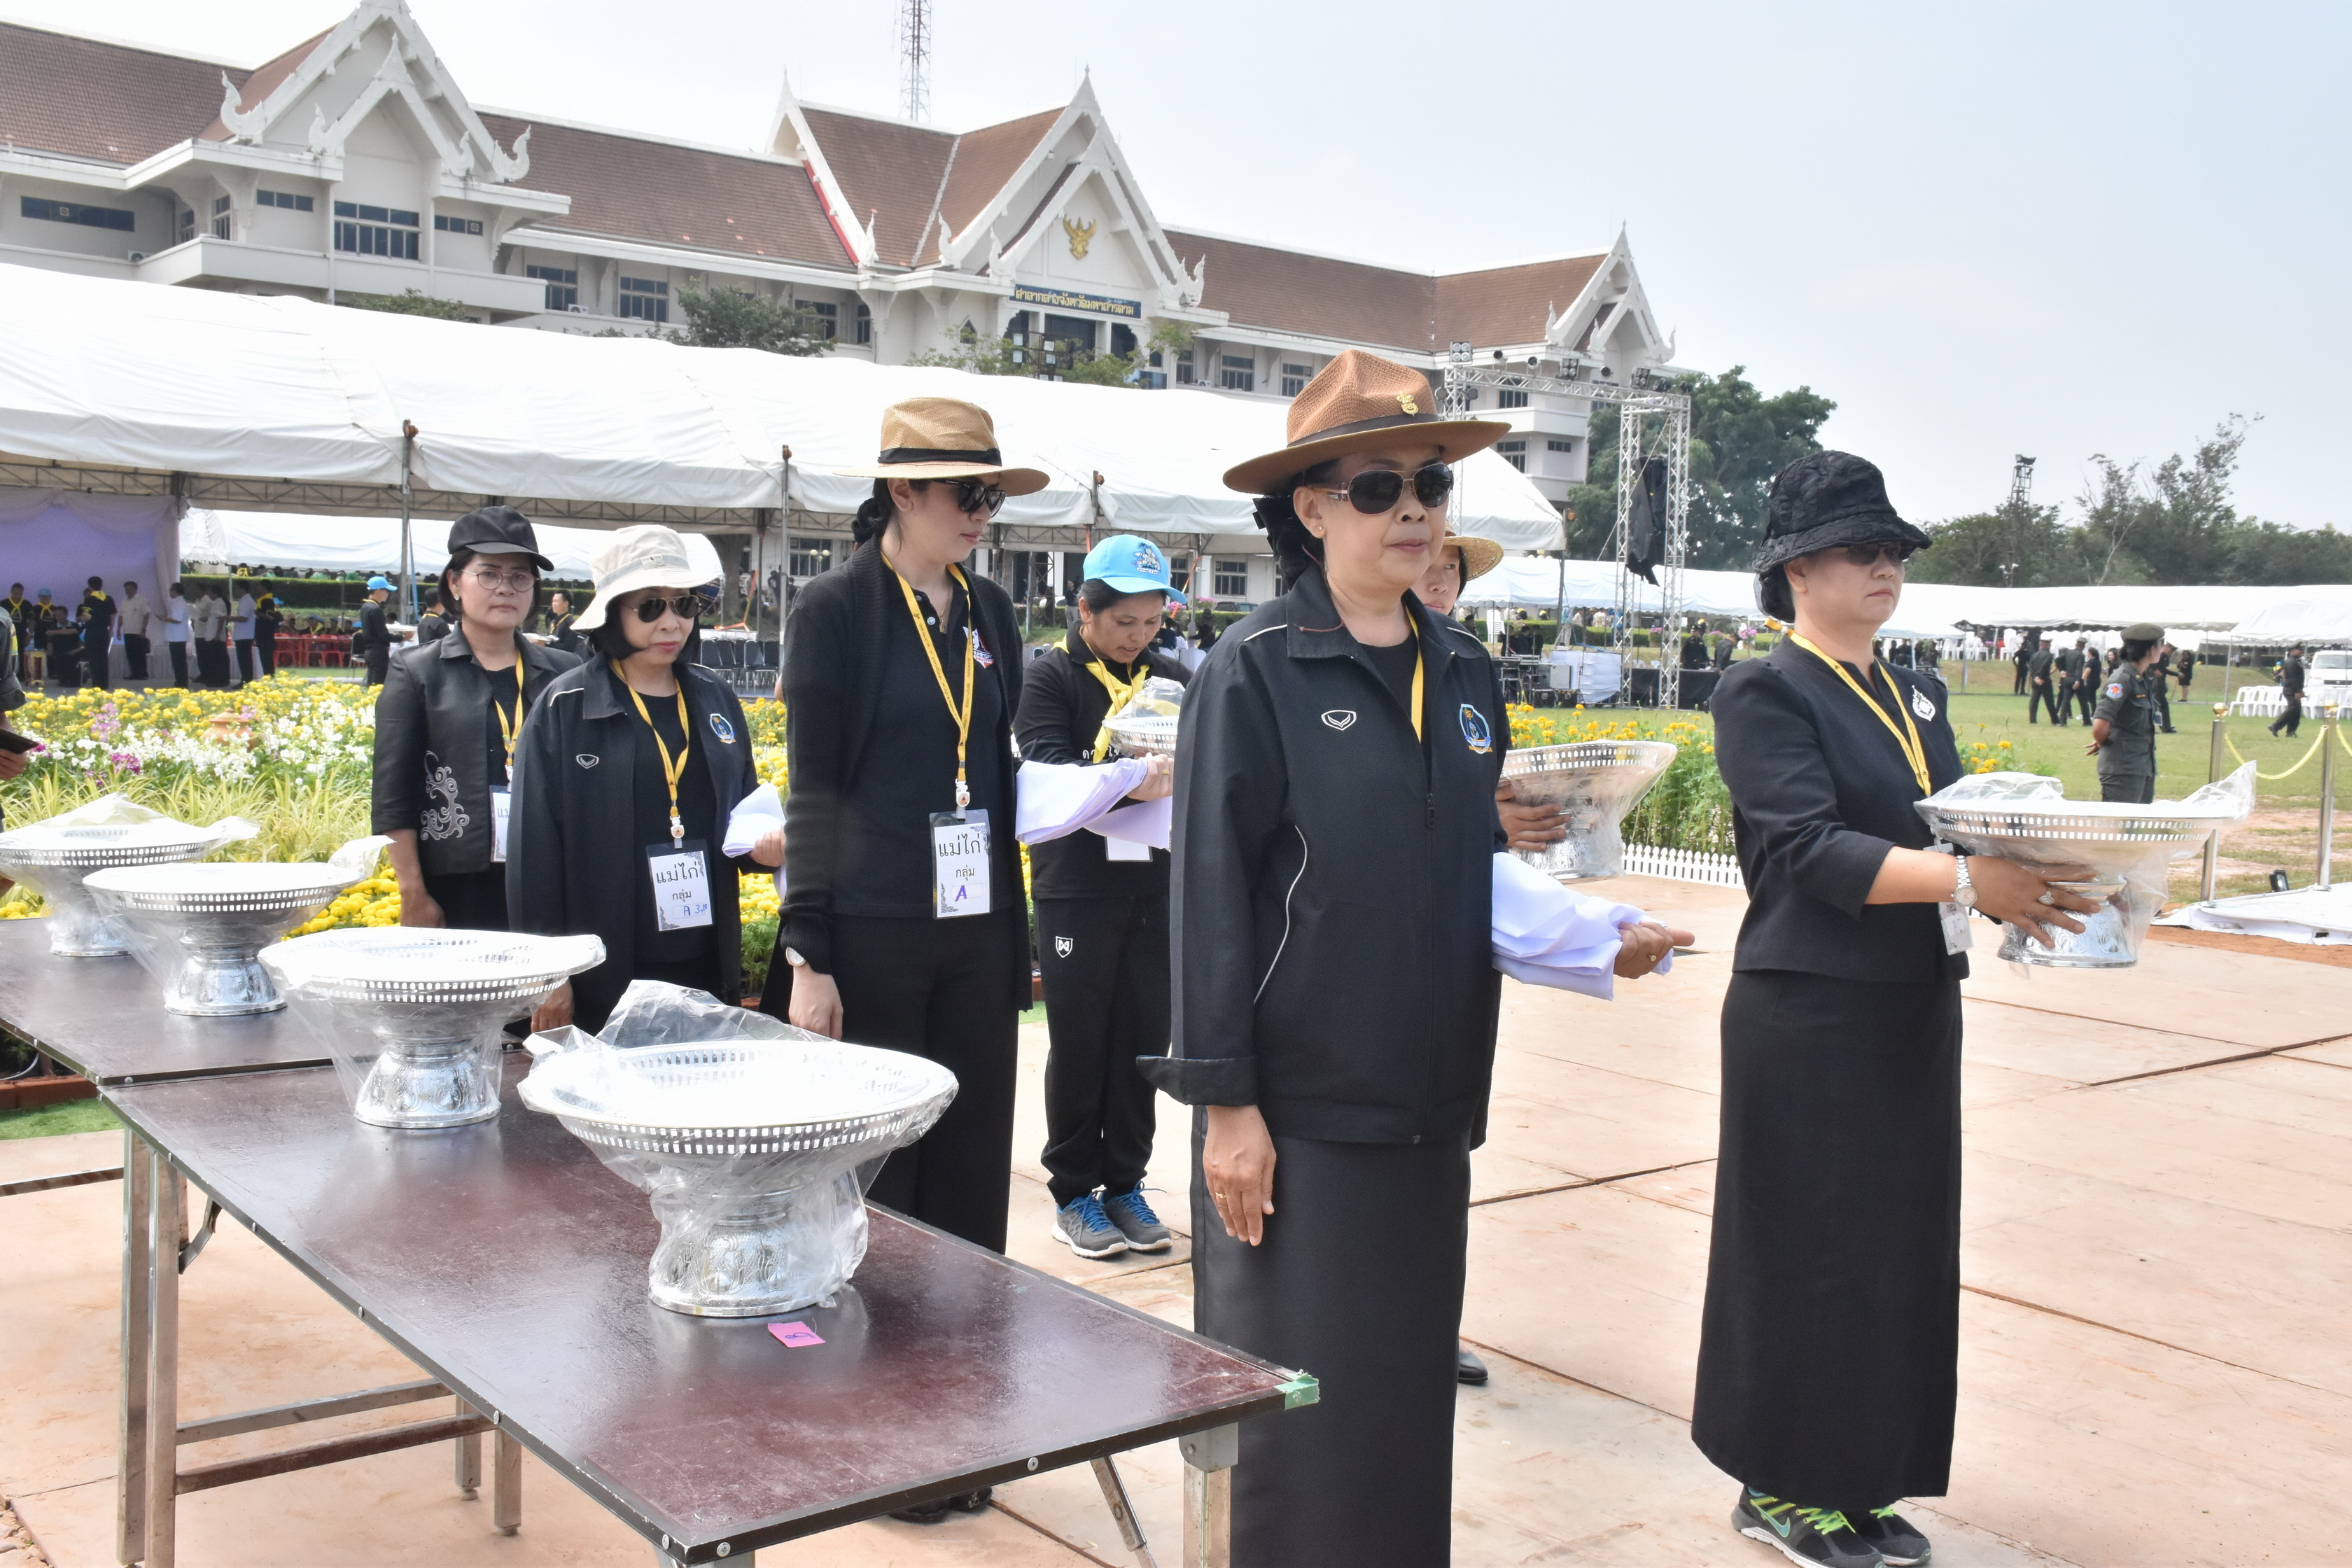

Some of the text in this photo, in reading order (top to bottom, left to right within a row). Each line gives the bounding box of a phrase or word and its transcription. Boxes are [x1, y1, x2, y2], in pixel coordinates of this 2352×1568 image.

[1015, 288, 1134, 316] ศาลากลางจังหวัดมหาสารคาม
[939, 832, 981, 858] แม่ไก่
[656, 861, 699, 884] แม่ไก่
[955, 864, 975, 881] กลุ่ม
[672, 889, 692, 902] กลุ่ม
[955, 884, 967, 902] A
[683, 905, 691, 916] A
